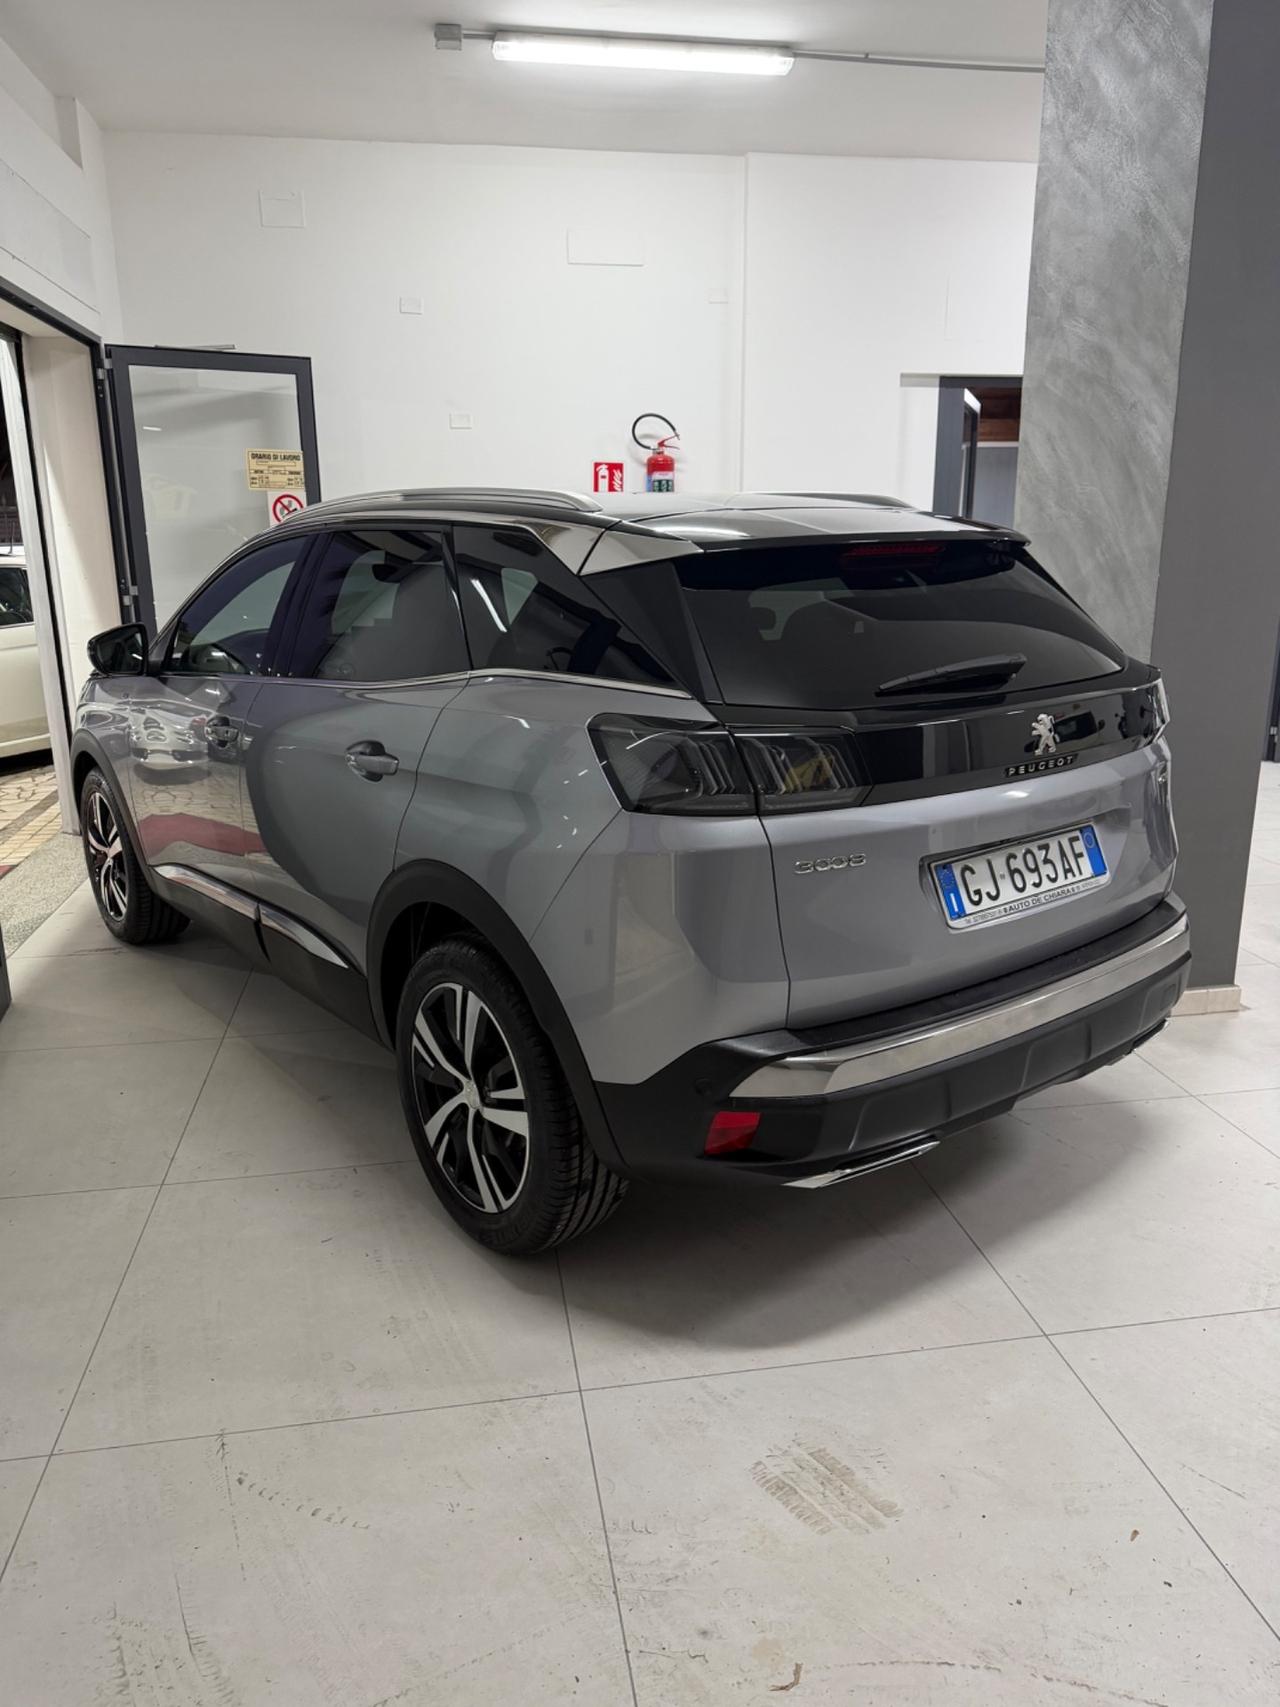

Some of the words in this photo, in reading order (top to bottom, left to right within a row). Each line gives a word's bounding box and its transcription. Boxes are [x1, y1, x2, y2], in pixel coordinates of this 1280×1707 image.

[1008, 756, 1073, 776] PEUGEOT
[794, 853, 866, 874] 3008
[1008, 900, 1031, 912] AUTO
[1031, 896, 1043, 905] DE
[1043, 887, 1071, 901] CHIARA
